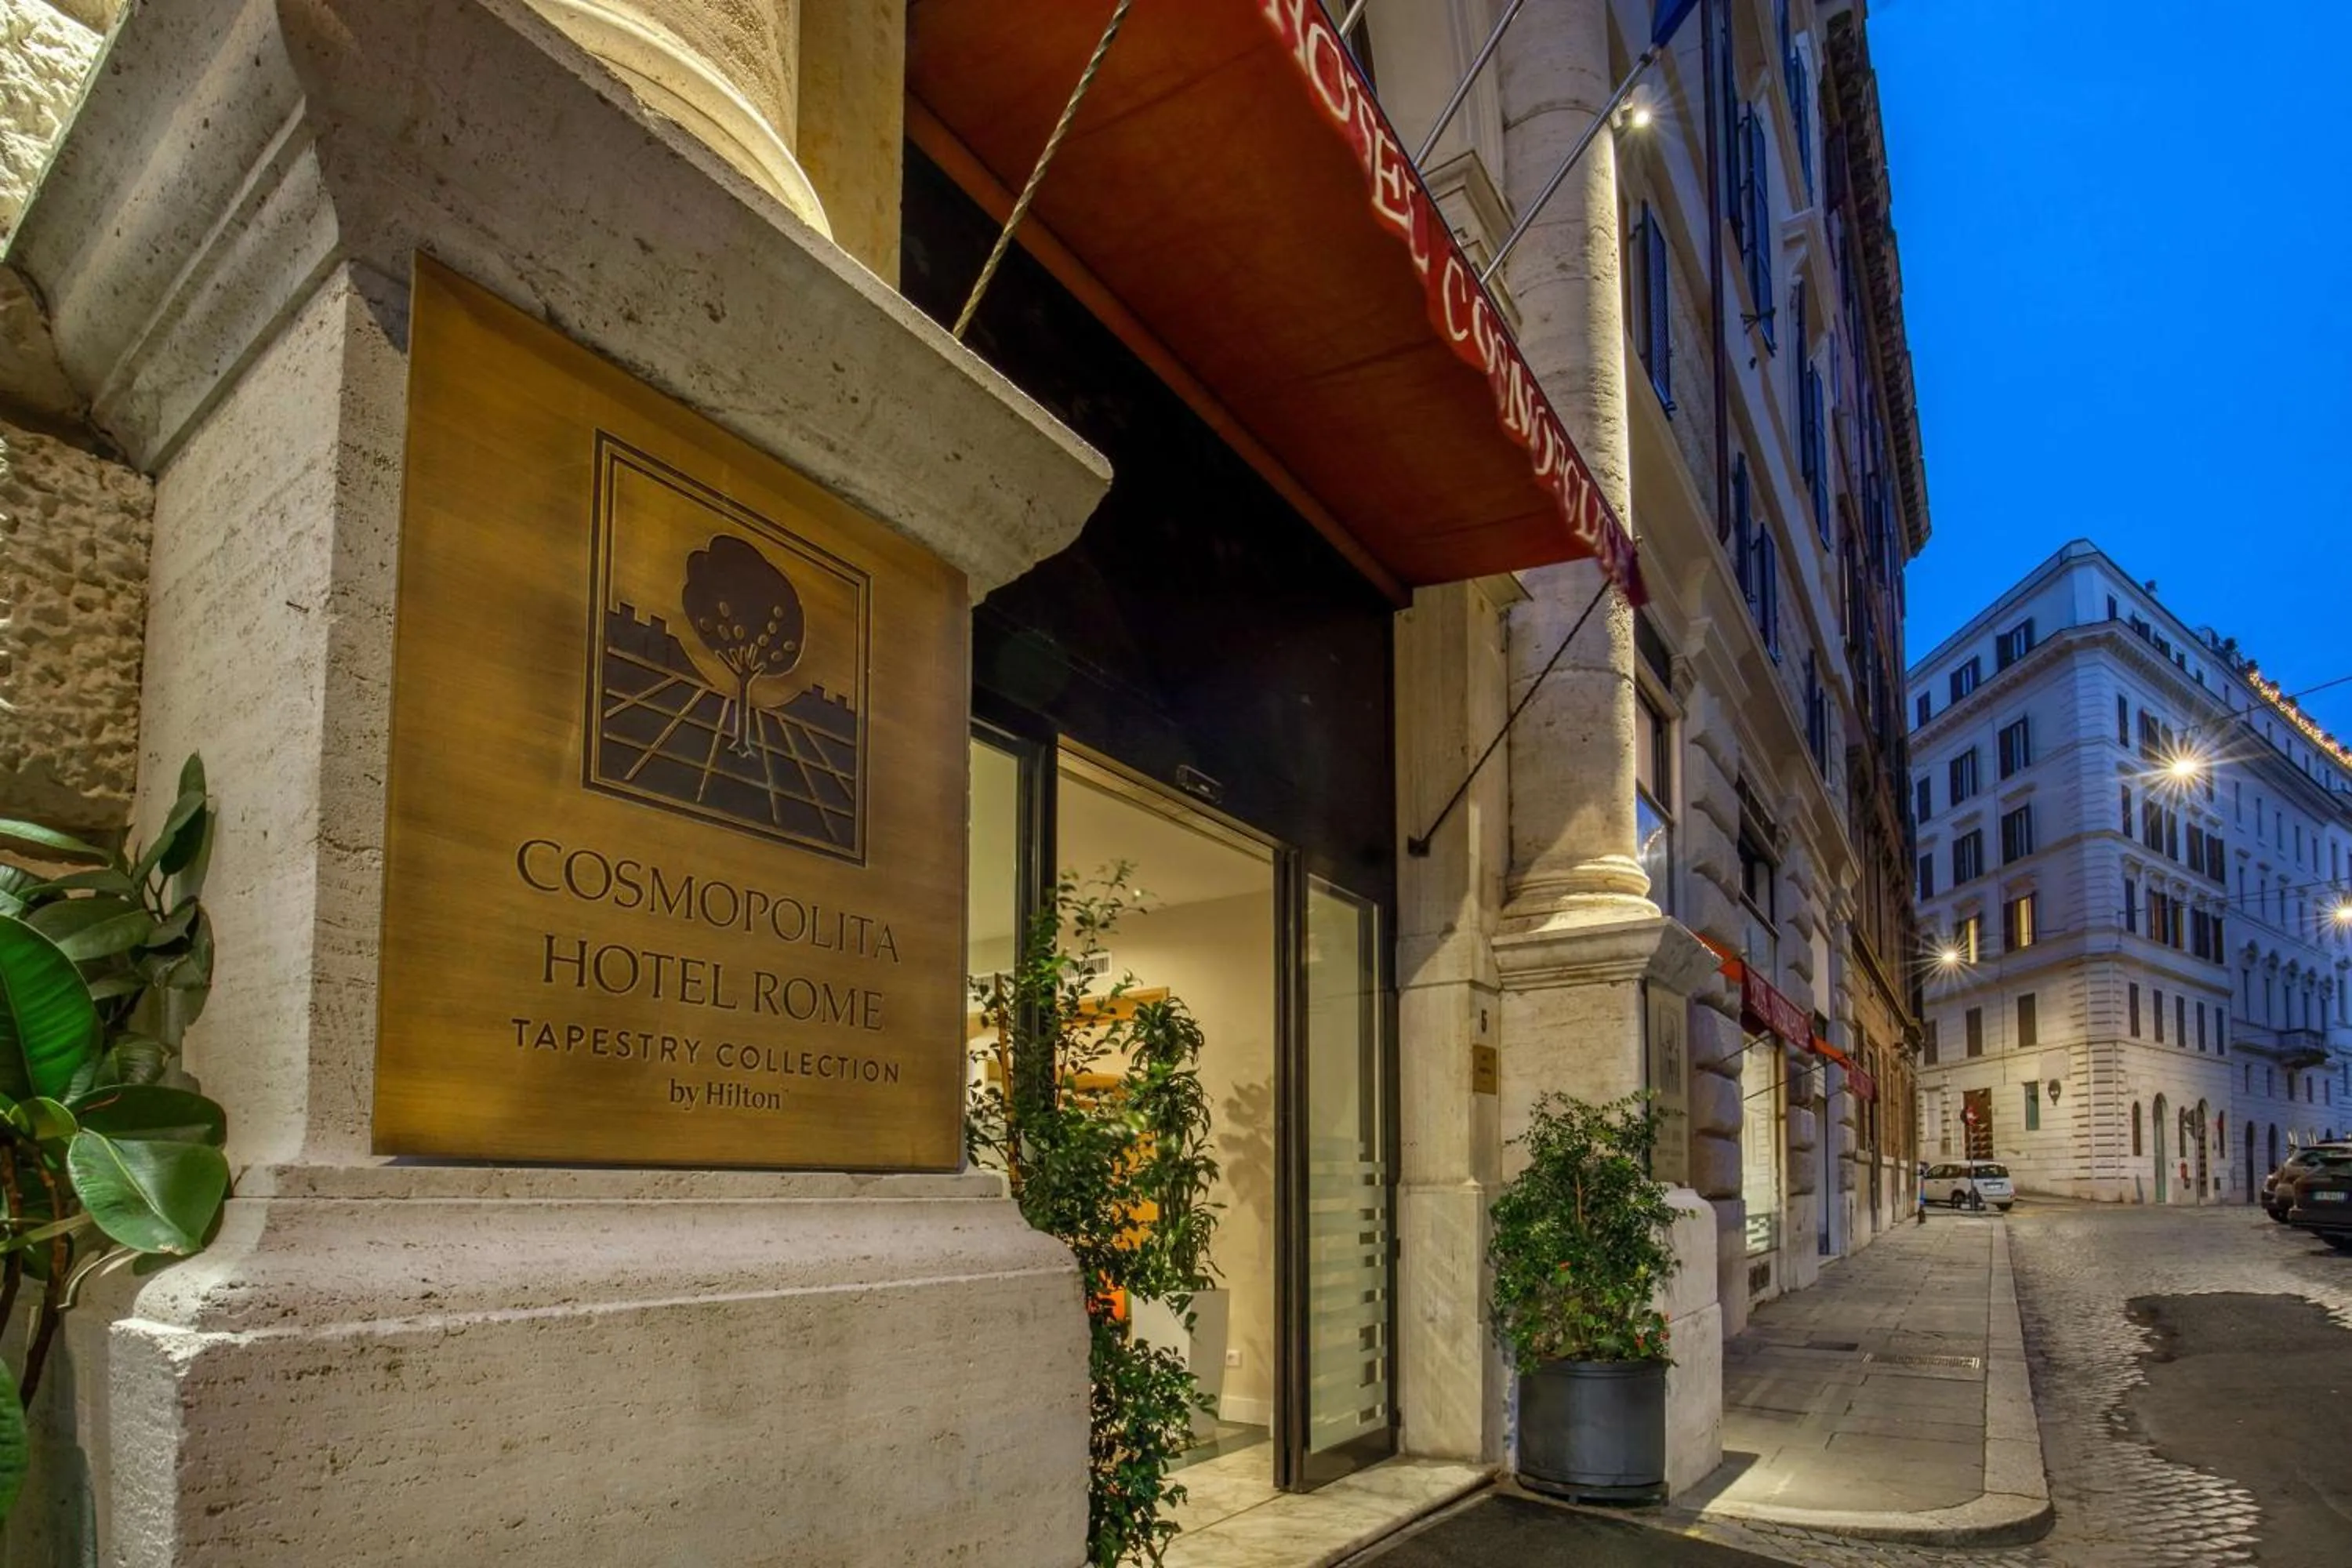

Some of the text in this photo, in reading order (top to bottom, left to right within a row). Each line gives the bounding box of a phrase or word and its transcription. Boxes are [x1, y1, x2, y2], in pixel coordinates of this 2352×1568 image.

[516, 839, 900, 964] COSMOPOLITA
[543, 934, 884, 1031] HOTEL ROME
[511, 1018, 899, 1084] TAPESTRY COLLECTION
[670, 1079, 780, 1111] by Hilton
